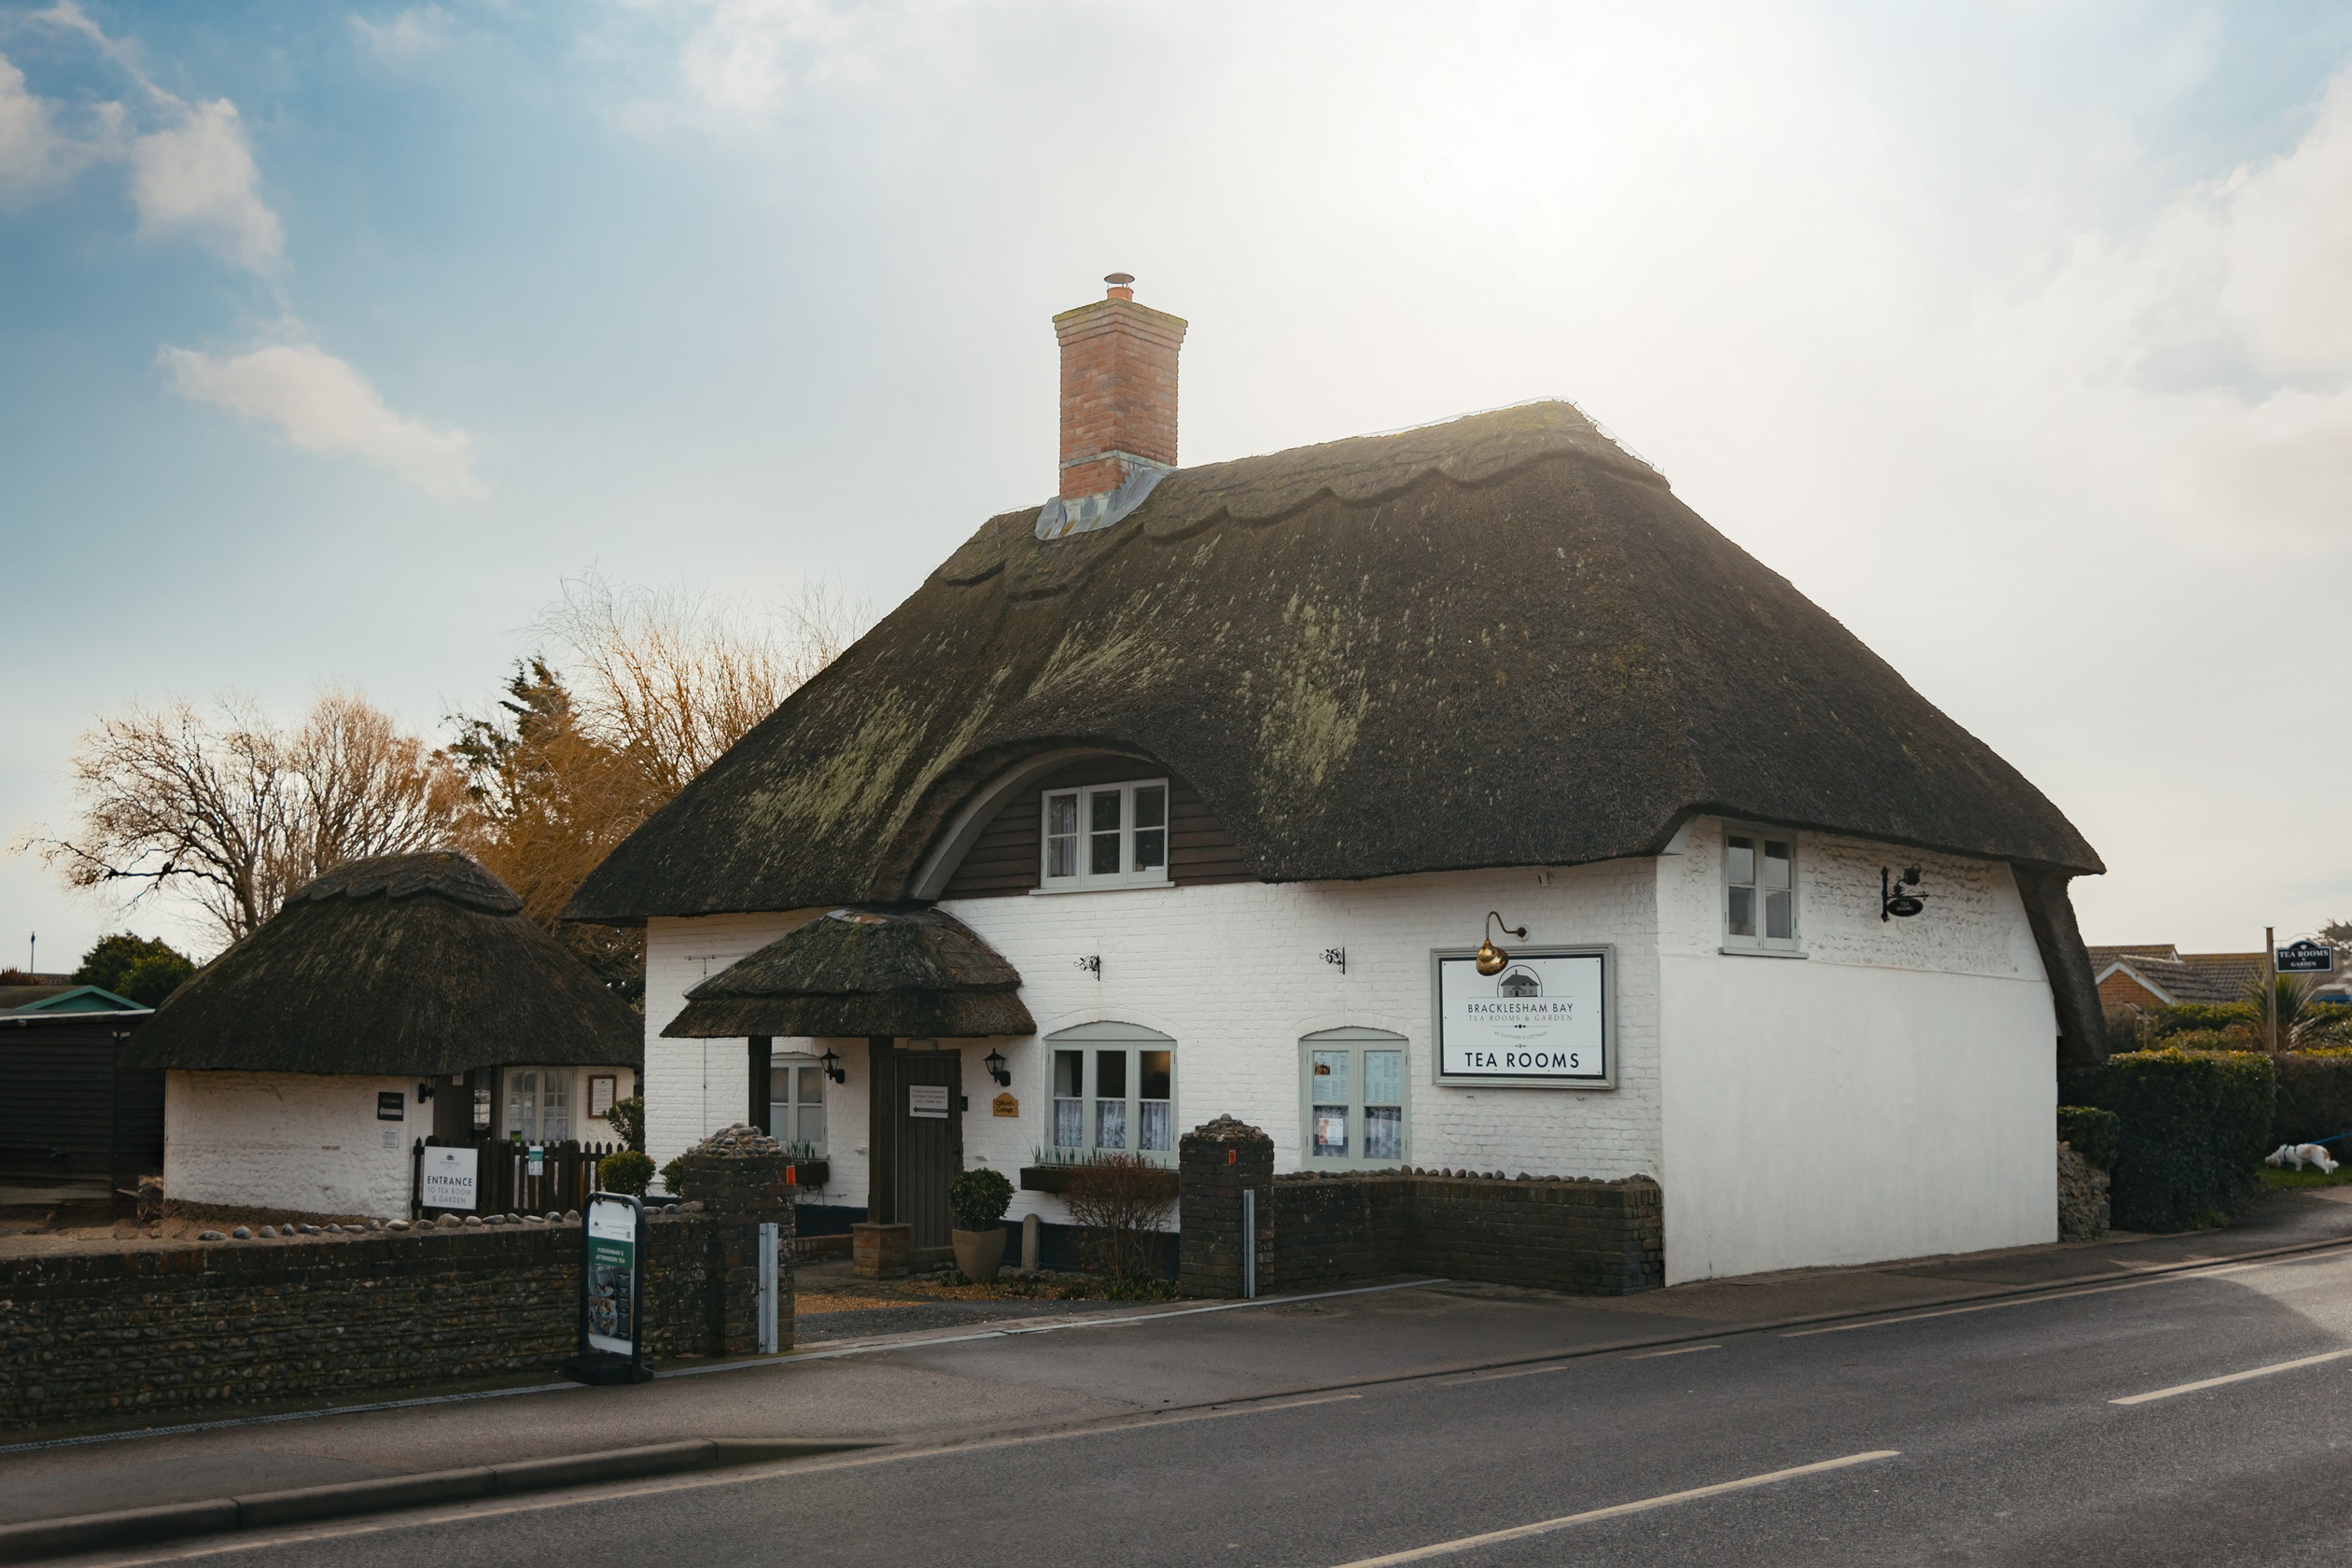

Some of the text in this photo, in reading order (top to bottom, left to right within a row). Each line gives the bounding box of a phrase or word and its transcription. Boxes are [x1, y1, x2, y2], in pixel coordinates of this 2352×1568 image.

[2297, 949, 2329, 958] ROOMS
[1467, 1002, 1574, 1014] BRACKLESHAM BAY
[1533, 1014, 1573, 1022] GARDEN
[1527, 1030, 1547, 1039] COTTAGE
[1464, 1052, 1579, 1068] TEA ROOMS
[427, 1175, 472, 1186] ENTRANCE
[439, 1196, 466, 1204] GARDEN
[597, 1247, 624, 1256] PLOUGHMAN'S
[595, 1254, 618, 1263] AFTERNOON
